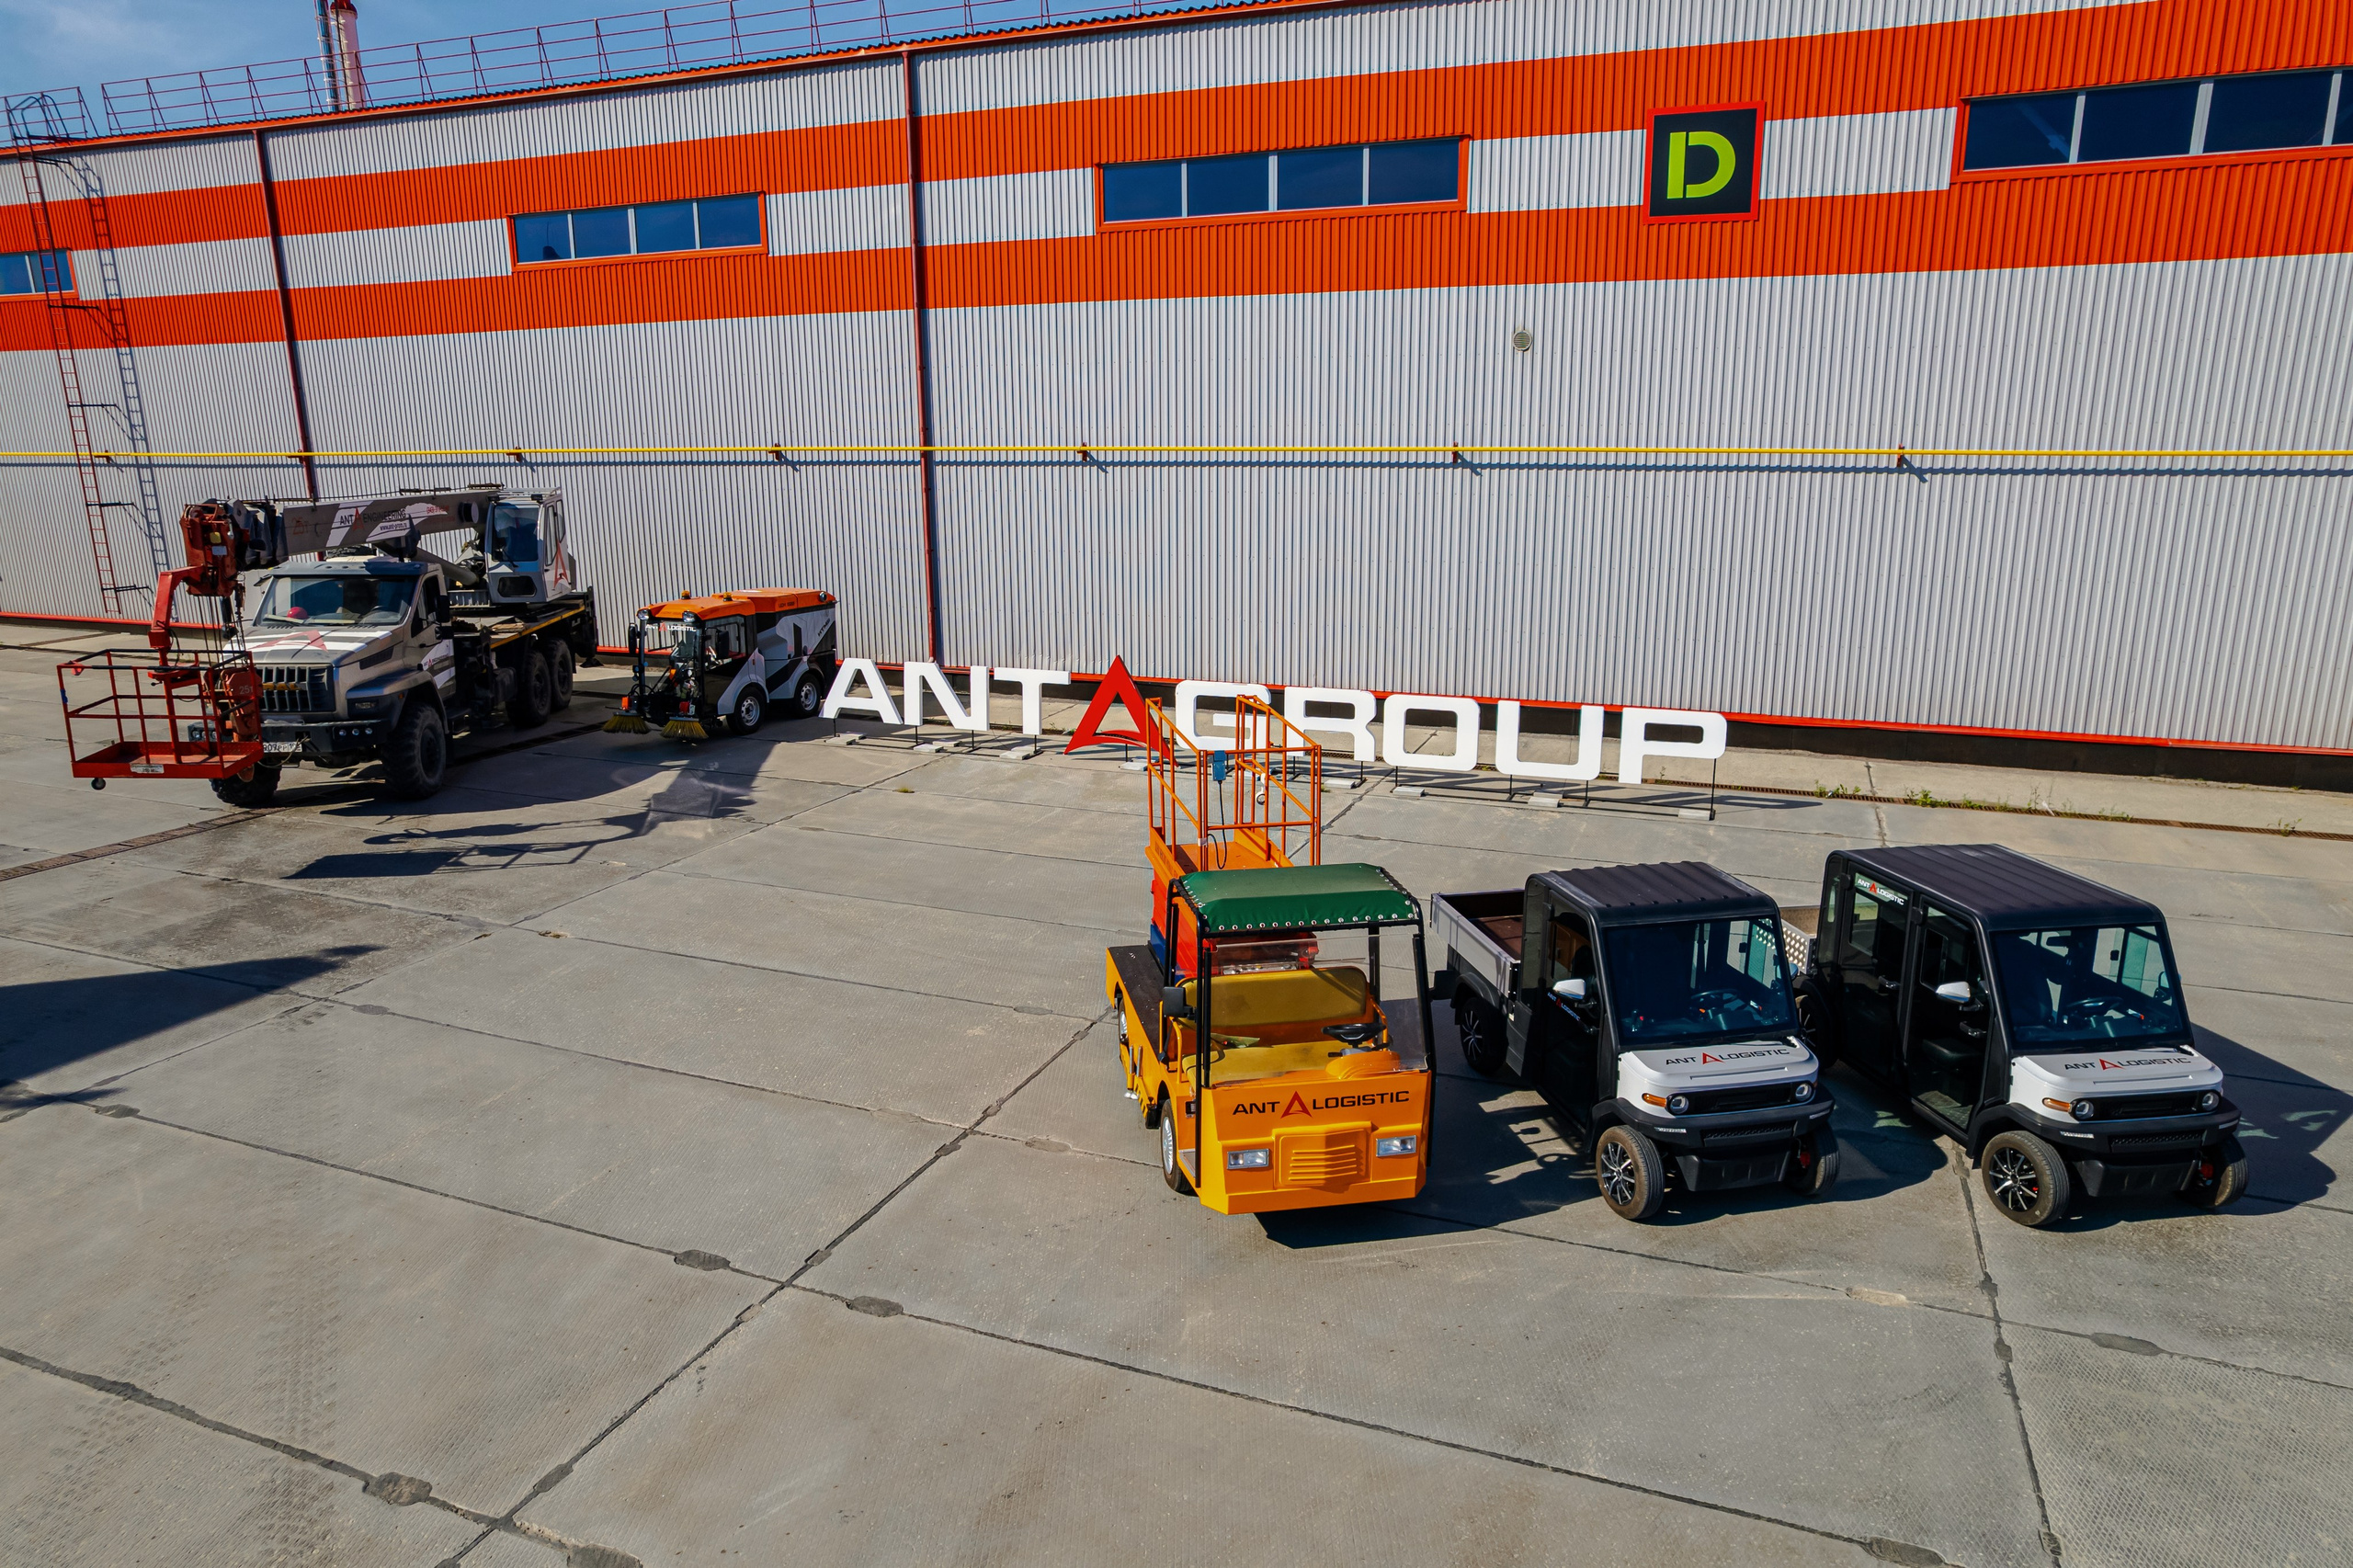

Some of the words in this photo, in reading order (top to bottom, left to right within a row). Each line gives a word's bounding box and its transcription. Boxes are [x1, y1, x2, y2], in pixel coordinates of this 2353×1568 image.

[1666, 131, 1736, 199] D
[339, 515, 354, 526] ANT
[363, 508, 406, 524] ENGINEERING
[819, 656, 1071, 735] ANT
[1175, 680, 1727, 784] GROUP
[1858, 879, 1870, 888] ANT
[1877, 887, 1904, 905] LOGISTIC
[1665, 1057, 1696, 1065] ANT
[1718, 1049, 1790, 1061] LOGISTIC
[2117, 1057, 2192, 1067] LOGISTIC
[1233, 1101, 1280, 1116] ANT
[1313, 1090, 1410, 1110] LOGISTIC
